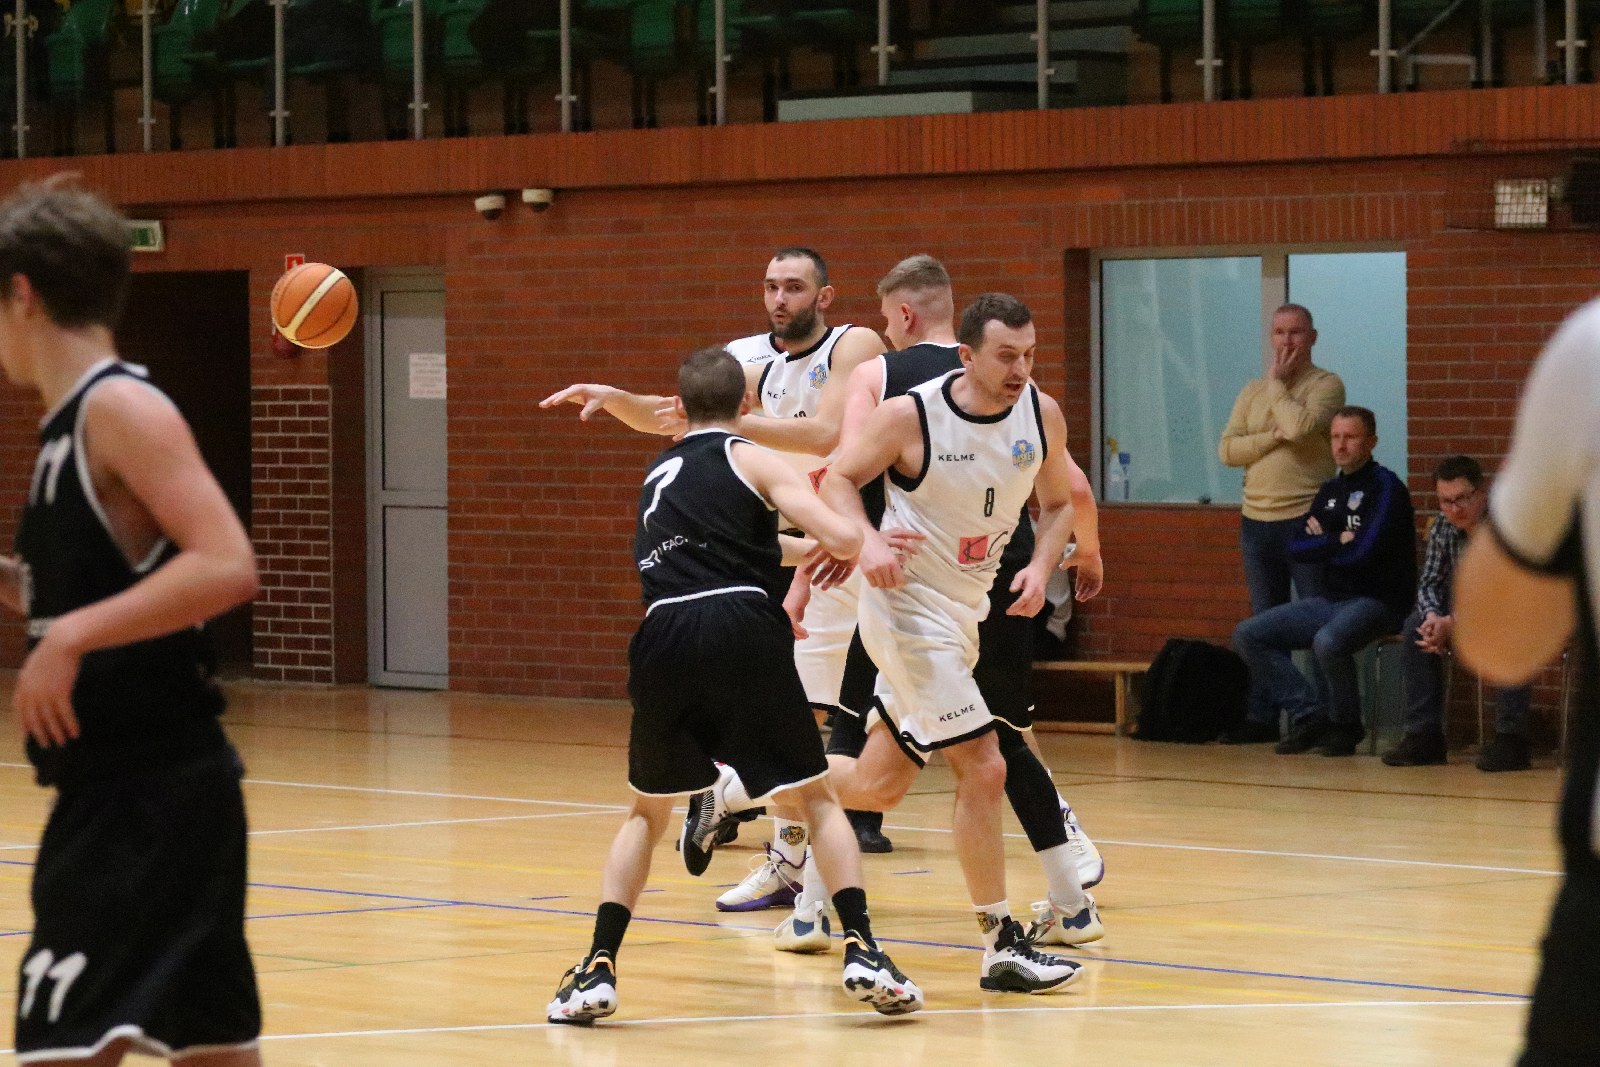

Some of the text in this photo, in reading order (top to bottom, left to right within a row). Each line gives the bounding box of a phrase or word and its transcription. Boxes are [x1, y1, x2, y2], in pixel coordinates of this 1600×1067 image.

[938, 453, 976, 462] KELME
[643, 455, 684, 532] 7
[983, 487, 995, 518] 8
[938, 703, 976, 723] KELME
[19, 947, 88, 1024] 11
